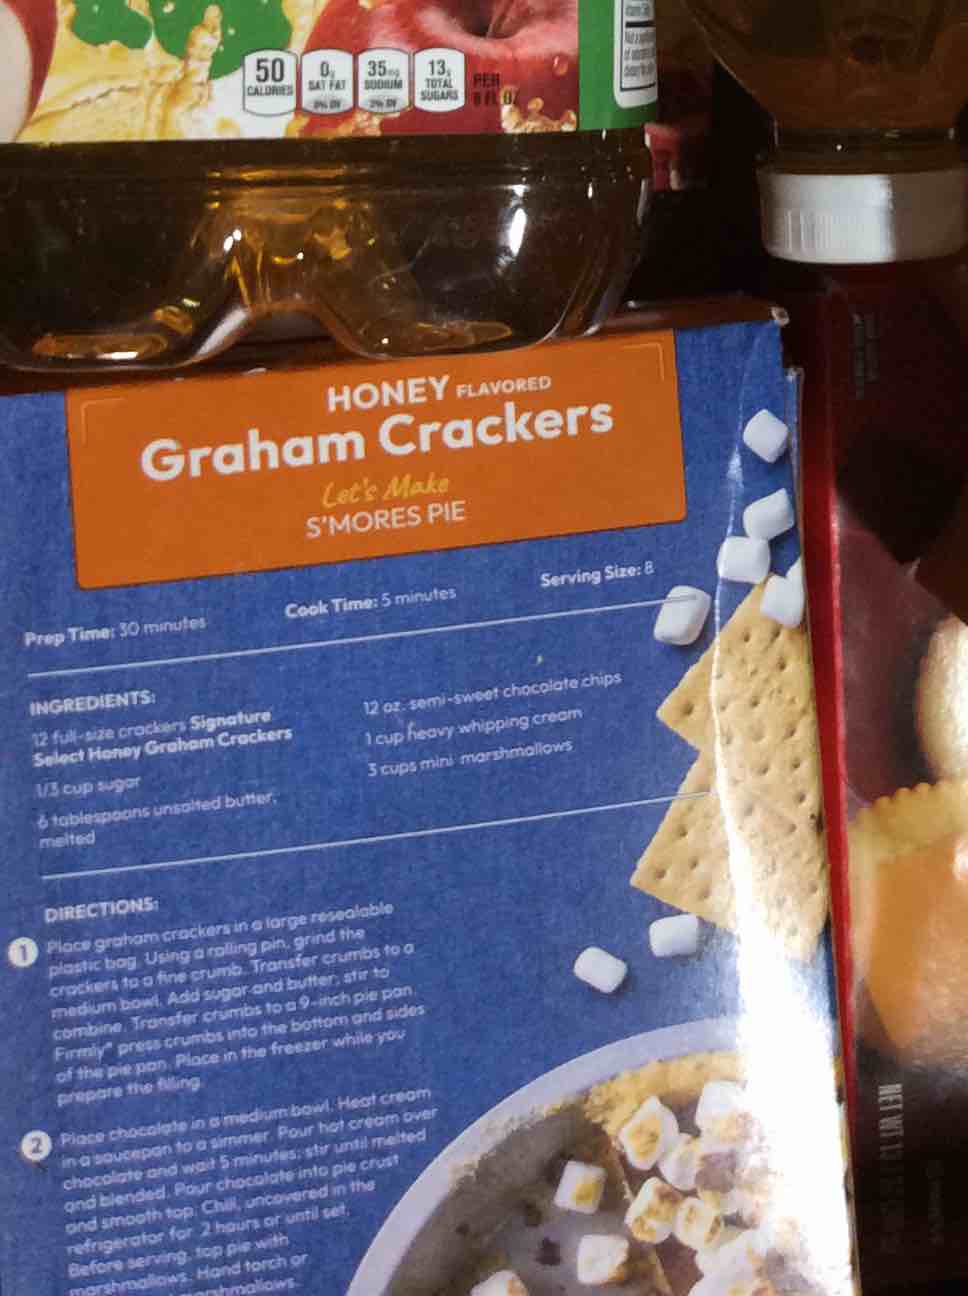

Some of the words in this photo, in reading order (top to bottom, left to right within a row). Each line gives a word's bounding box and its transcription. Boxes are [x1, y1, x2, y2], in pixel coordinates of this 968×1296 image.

[255, 57, 284, 83] 50
[364, 79, 403, 90] SODIUM
[426, 78, 453, 88] TOTAL
[247, 85, 293, 97] CALORIES
[326, 375, 449, 413] HONEY
[456, 375, 552, 399] FLAVORED
[140, 428, 366, 481] Graham
[378, 401, 614, 456] Crackers
[321, 478, 377, 509] Let's
[384, 472, 449, 501] Make
[306, 504, 422, 538] S'MORES
[426, 500, 467, 524] PIE
[540, 569, 601, 589] Serving
[604, 563, 641, 580] Size:
[644, 560, 654, 575] 8
[285, 602, 329, 619] Cook
[331, 596, 379, 612] Time:
[381, 594, 392, 607] 5
[395, 586, 457, 606] minutes
[24, 631, 65, 648] Prep
[67, 626, 115, 642] Time:
[119, 622, 140, 638] 30
[143, 615, 207, 634] minutes
[28, 689, 156, 716] INGREDIENTS:
[363, 699, 380, 715] 12
[410, 686, 501, 711] semi-sweet
[503, 676, 579, 698] chocolate
[581, 670, 623, 689] chips
[31, 733, 48, 747] 12
[52, 727, 114, 746] full-size
[119, 720, 187, 740] crackers
[189, 709, 272, 732] Signature
[375, 730, 405, 748] cup
[407, 719, 455, 743] heavy
[458, 713, 530, 735] whipping
[532, 706, 583, 724] cream
[34, 750, 85, 767] Select
[88, 744, 142, 762] Honey
[145, 738, 215, 756] Graham
[218, 727, 293, 747] Crackers
[367, 761, 378, 777] 3
[380, 759, 417, 777] cups
[419, 754, 453, 770] mini
[460, 739, 573, 765] marshmallows
[37, 782, 60, 798] 1/3
[63, 781, 93, 796] cup
[97, 775, 141, 792] sugar
[37, 816, 48, 829] 6
[53, 806, 151, 828] tablespoons
[153, 796, 222, 816] unsalted
[39, 831, 96, 849] melted
[45, 897, 159, 923] DIRECTIONS:
[878, 1083, 903, 1111] NET
